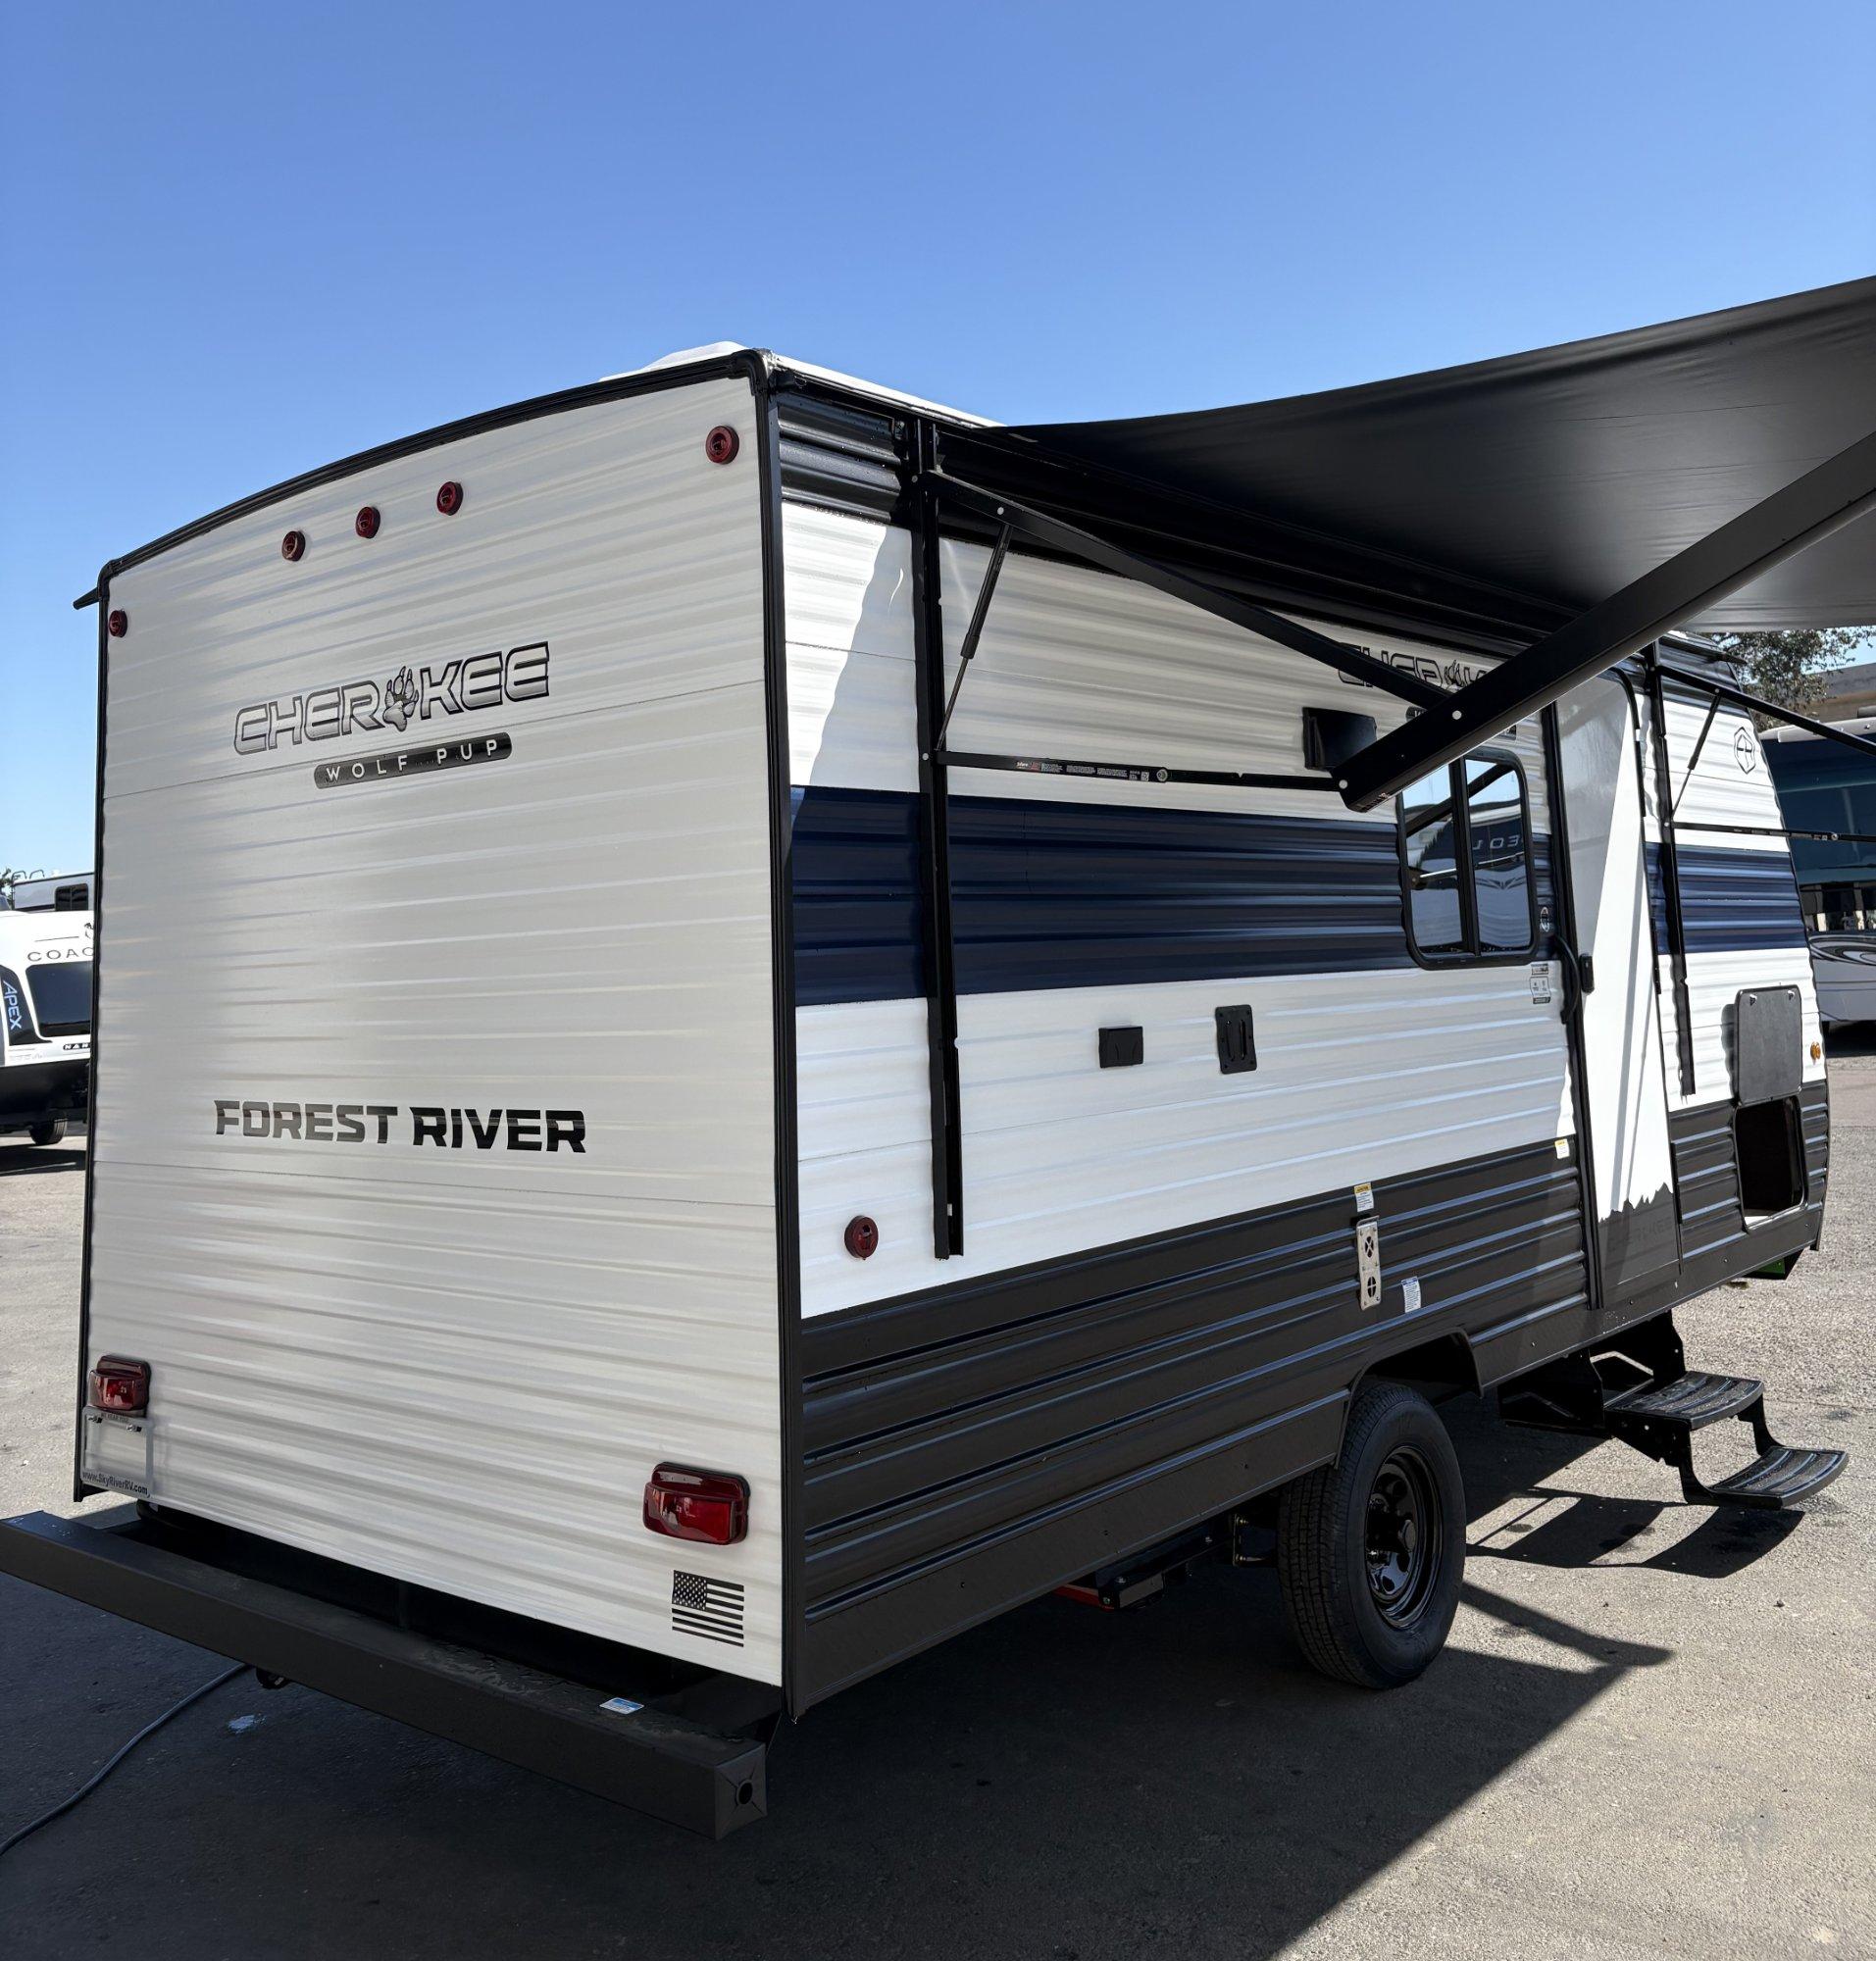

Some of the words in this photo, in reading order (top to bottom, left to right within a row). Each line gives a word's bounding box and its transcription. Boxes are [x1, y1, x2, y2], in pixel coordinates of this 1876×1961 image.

[326, 754, 408, 781] WOLF
[436, 738, 498, 765] PUP
[3, 980, 23, 1031] APEX
[214, 1099, 398, 1145] FOREST
[409, 1106, 587, 1154] RIVER
